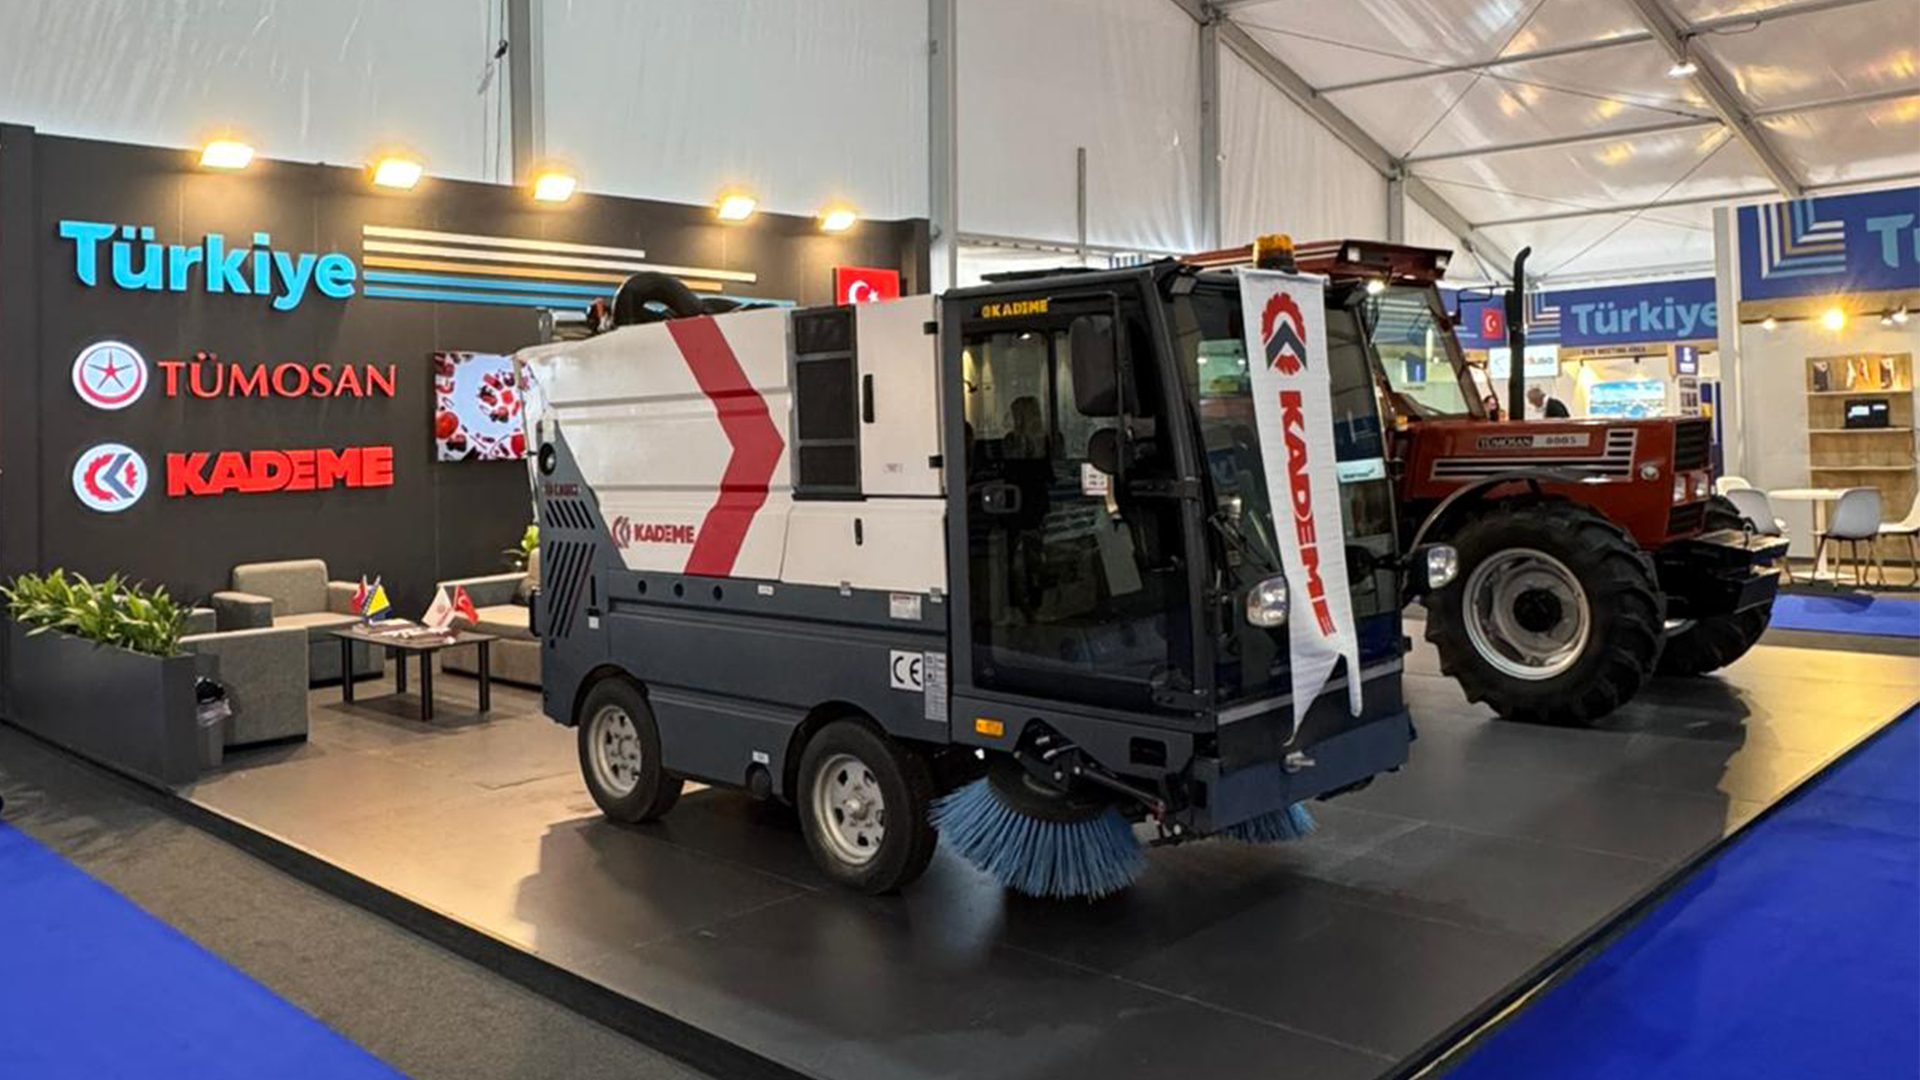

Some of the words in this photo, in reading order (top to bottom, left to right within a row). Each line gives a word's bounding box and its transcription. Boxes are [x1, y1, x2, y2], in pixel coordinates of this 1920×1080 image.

[60, 220, 356, 311] Türkiye
[1571, 297, 1717, 337] Türkiye
[158, 353, 397, 398] TÜMOSAN
[167, 446, 394, 496] KADEME
[634, 523, 694, 543] KADEME
[1279, 390, 1336, 637] KADEME
